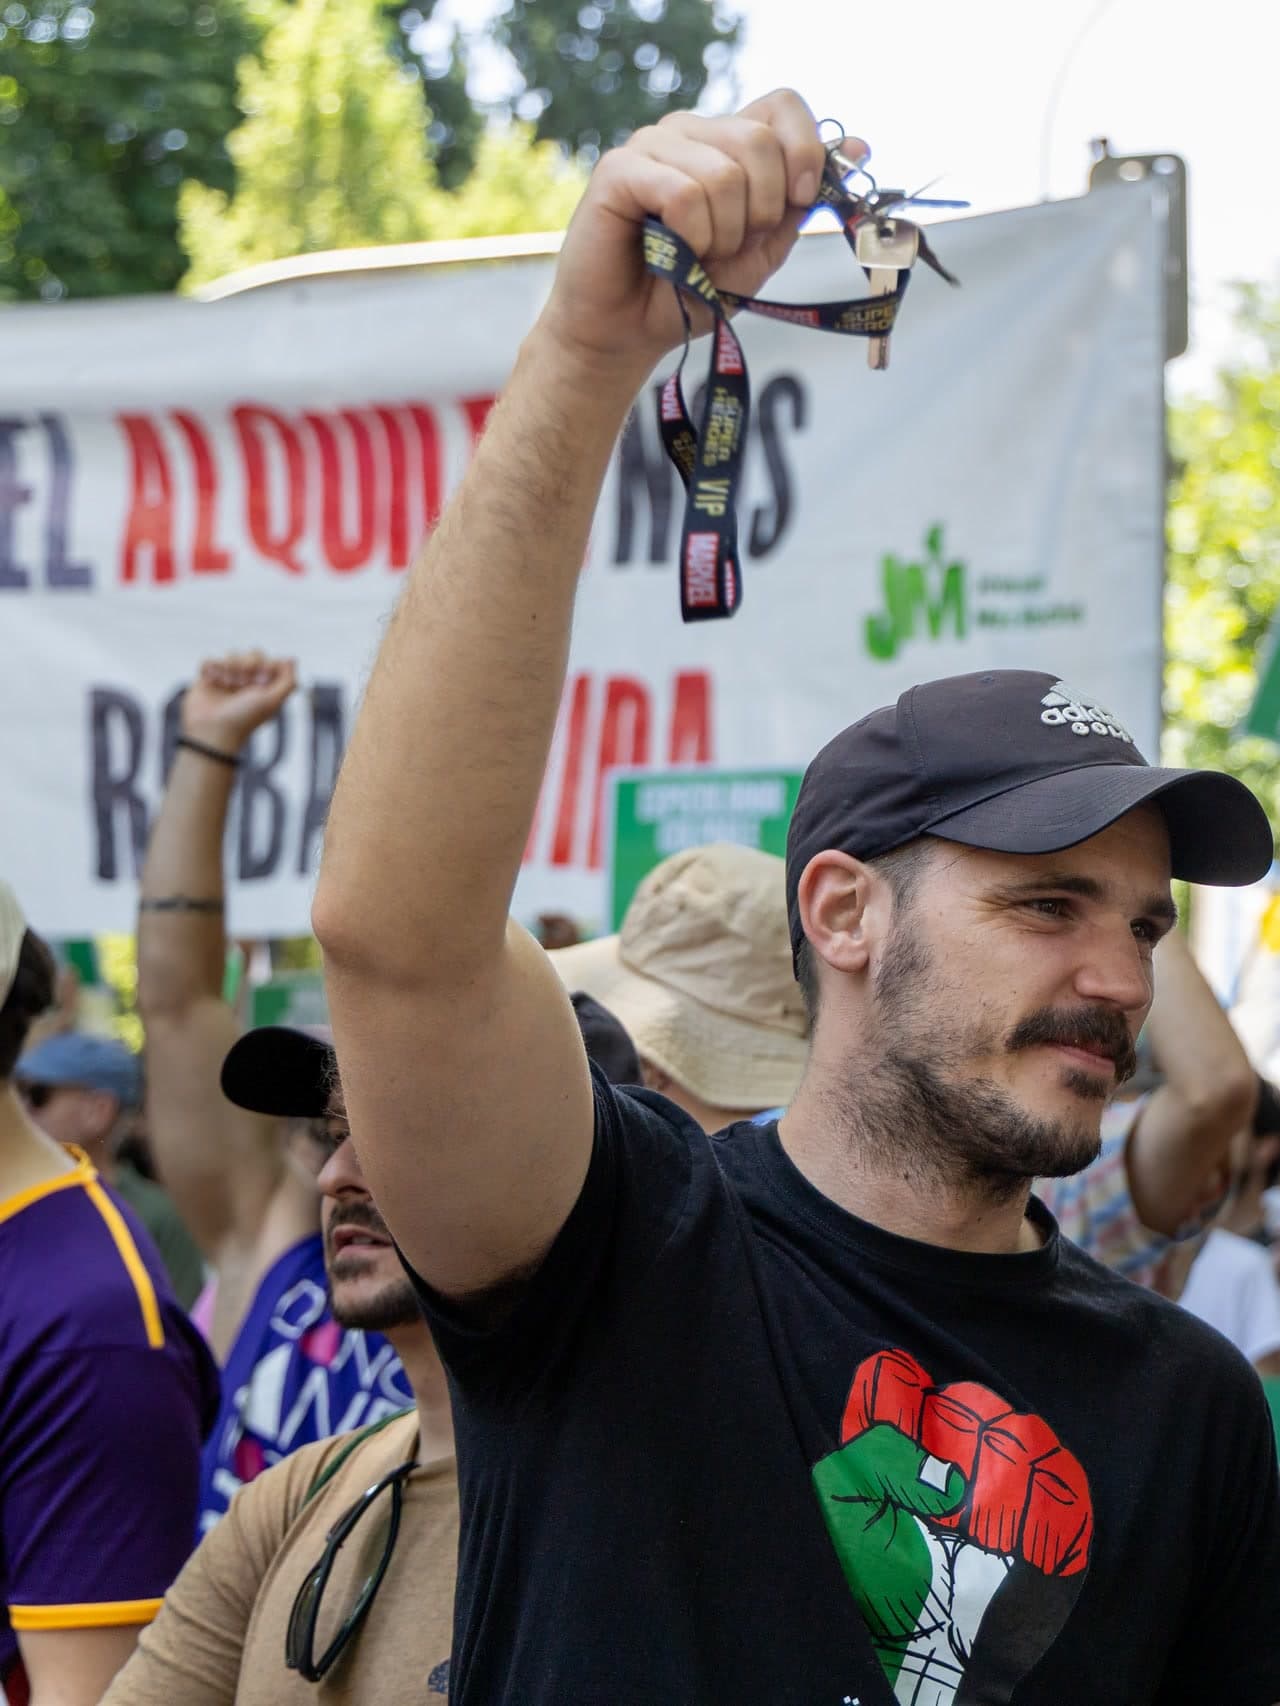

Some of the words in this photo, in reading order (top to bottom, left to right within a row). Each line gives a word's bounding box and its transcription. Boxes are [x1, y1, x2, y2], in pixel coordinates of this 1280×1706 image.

[115, 393, 502, 588] ALQUIL
[694, 479, 730, 517] VIP
[686, 532, 719, 607] MARVEL
[521, 667, 714, 870] IDA
